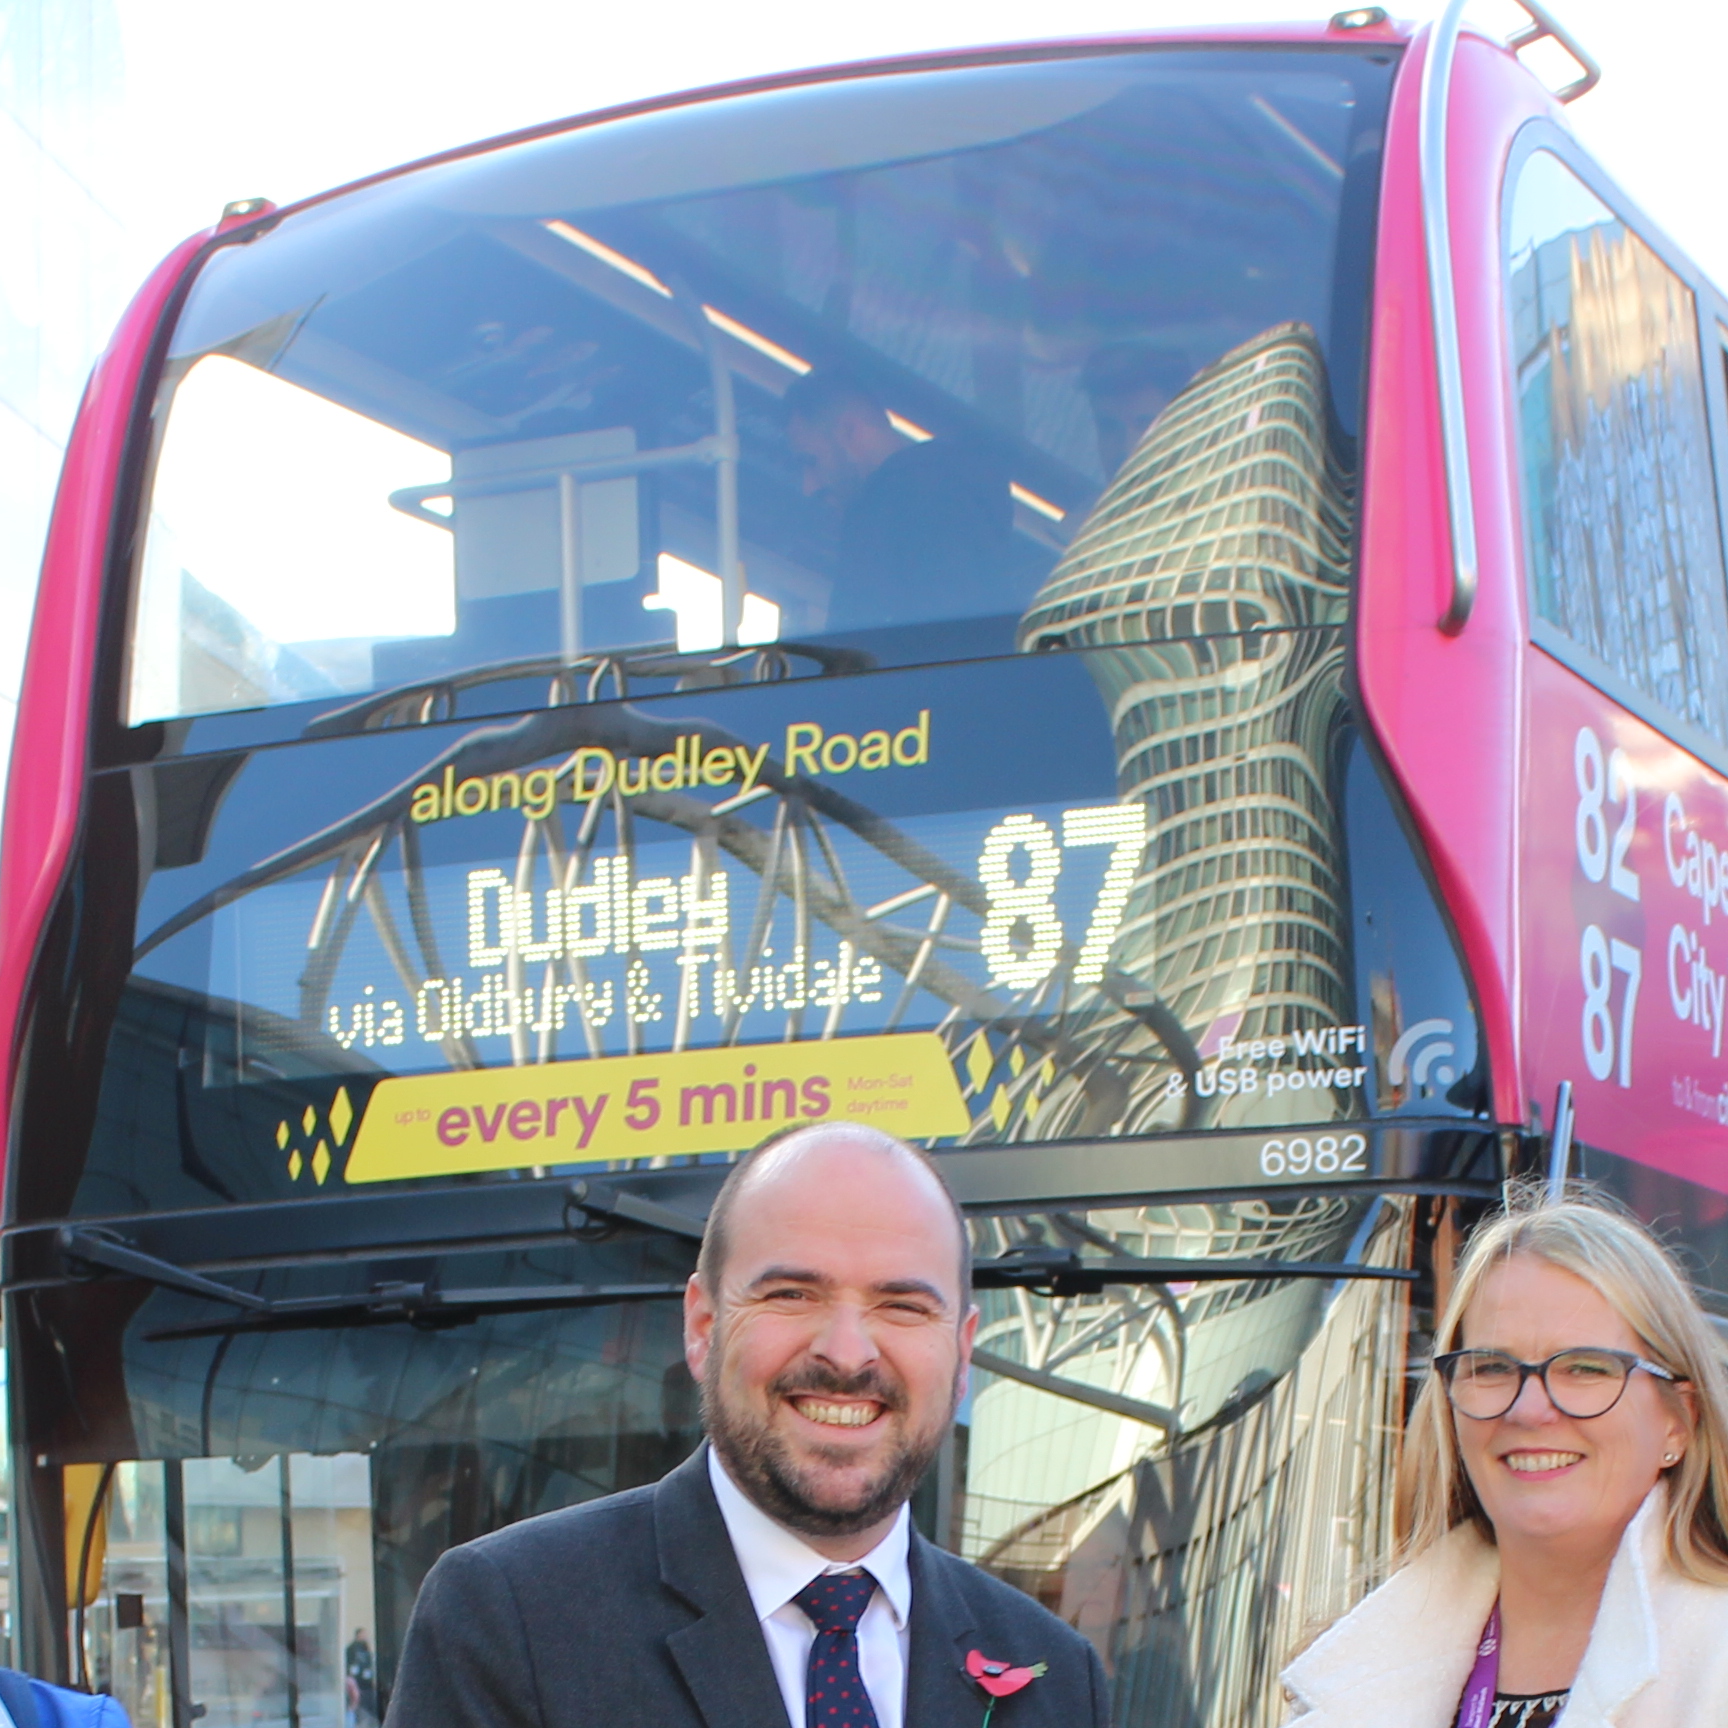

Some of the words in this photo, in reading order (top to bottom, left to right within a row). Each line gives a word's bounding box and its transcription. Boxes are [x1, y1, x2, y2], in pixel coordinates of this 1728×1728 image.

[410, 766, 556, 823] along
[574, 734, 770, 803] Dudley
[784, 710, 931, 777] Road
[1574, 726, 1640, 903] 82
[467, 855, 729, 967] Dudley
[978, 803, 1146, 990] 87
[329, 985, 403, 1049] via
[417, 973, 613, 1041] Oldbury
[627, 960, 662, 1023] &
[676, 941, 882, 1018] Tividale
[1580, 924, 1642, 1089] 87
[1668, 923, 1726, 1058] City
[847, 1073, 914, 1092] Mon-Sat
[1164, 1071, 1190, 1099] &
[1195, 1069, 1259, 1097] USB
[1267, 1065, 1368, 1097] power
[1219, 1036, 1286, 1061] Free
[1292, 1025, 1367, 1057] WiFi
[394, 1111, 415, 1127] up
[416, 1107, 431, 1122] to
[436, 1091, 608, 1149] every
[624, 1078, 661, 1130] 5
[679, 1064, 832, 1127] mins
[846, 1095, 909, 1117] daytime
[1260, 1134, 1367, 1177] 6982
